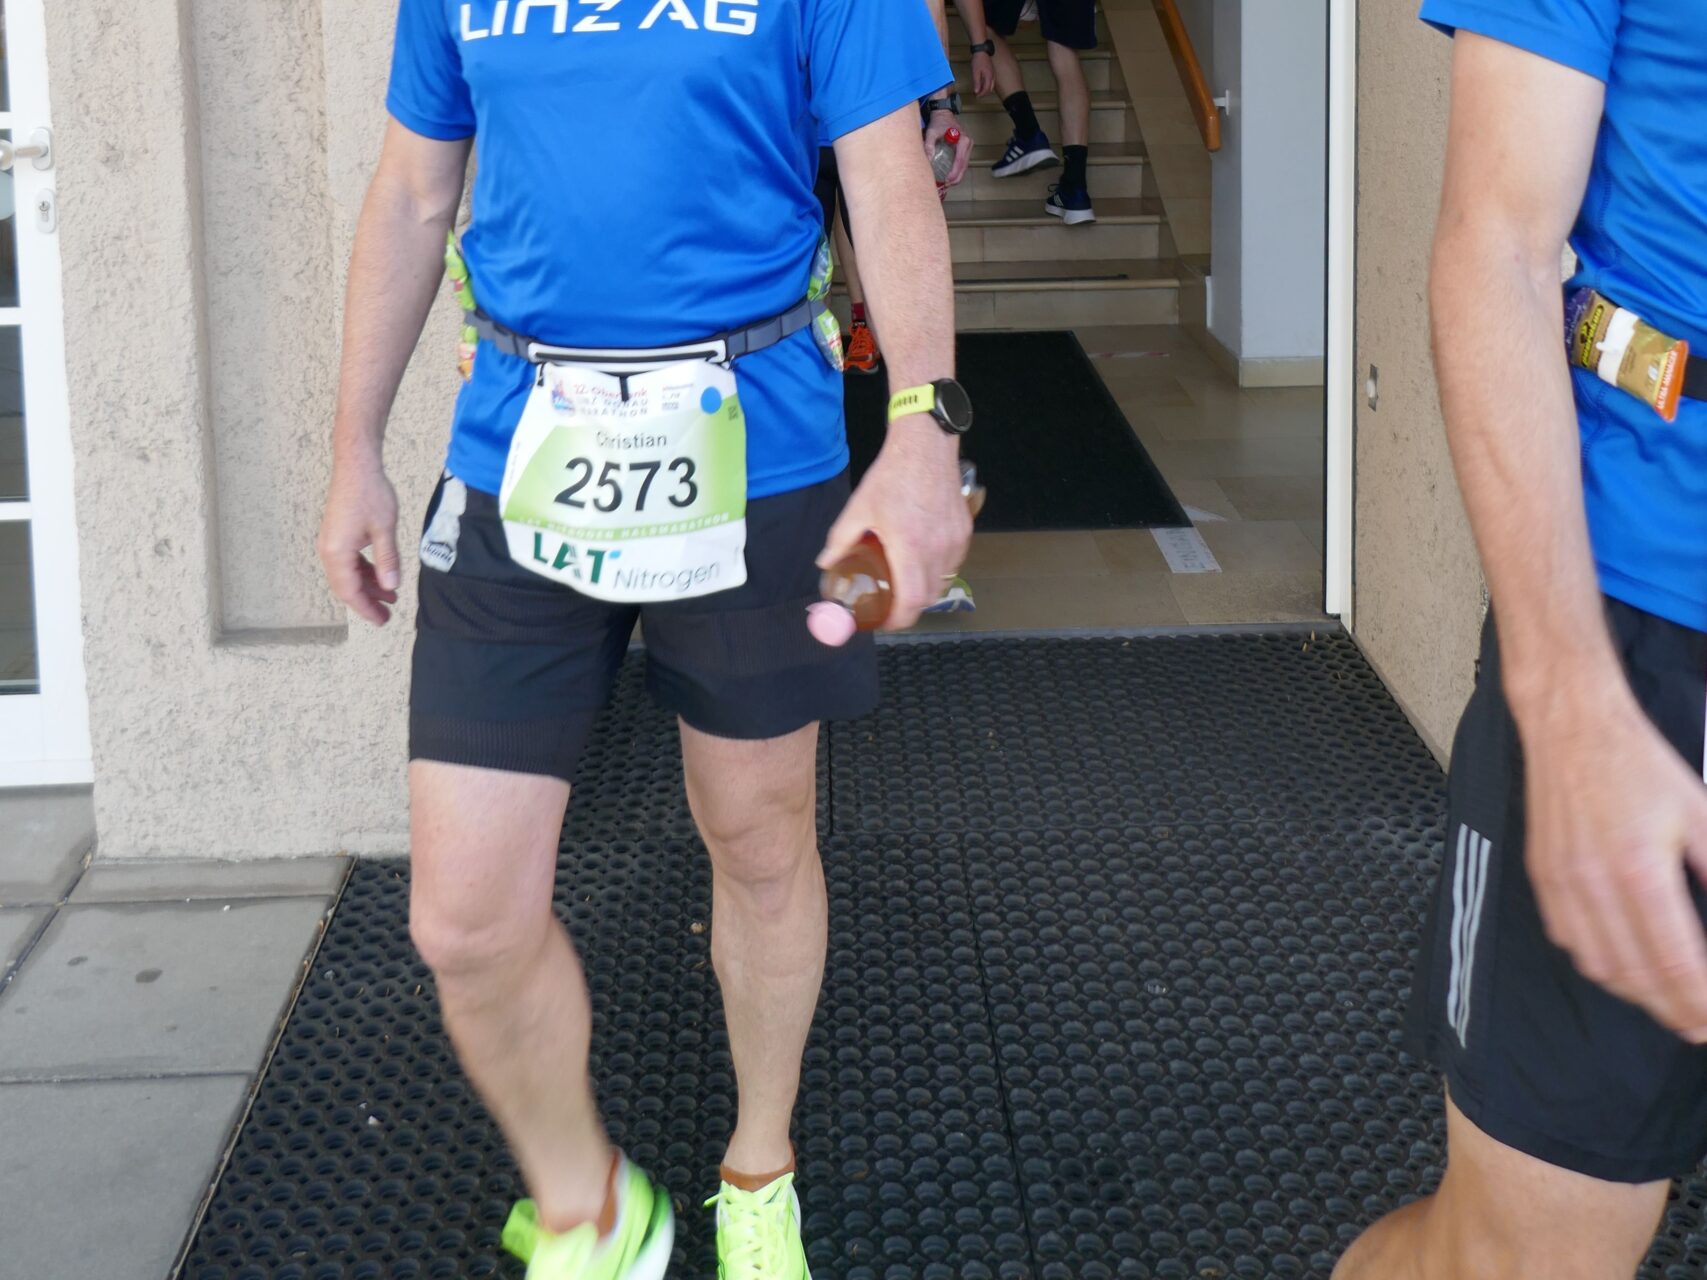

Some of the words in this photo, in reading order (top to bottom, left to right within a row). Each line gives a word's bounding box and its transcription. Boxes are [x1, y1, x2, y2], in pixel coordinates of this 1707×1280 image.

[590, 385, 648, 399] Oberank
[554, 456, 698, 512] 2573
[533, 531, 607, 584] LAT
[613, 561, 721, 593] Nitrogen
